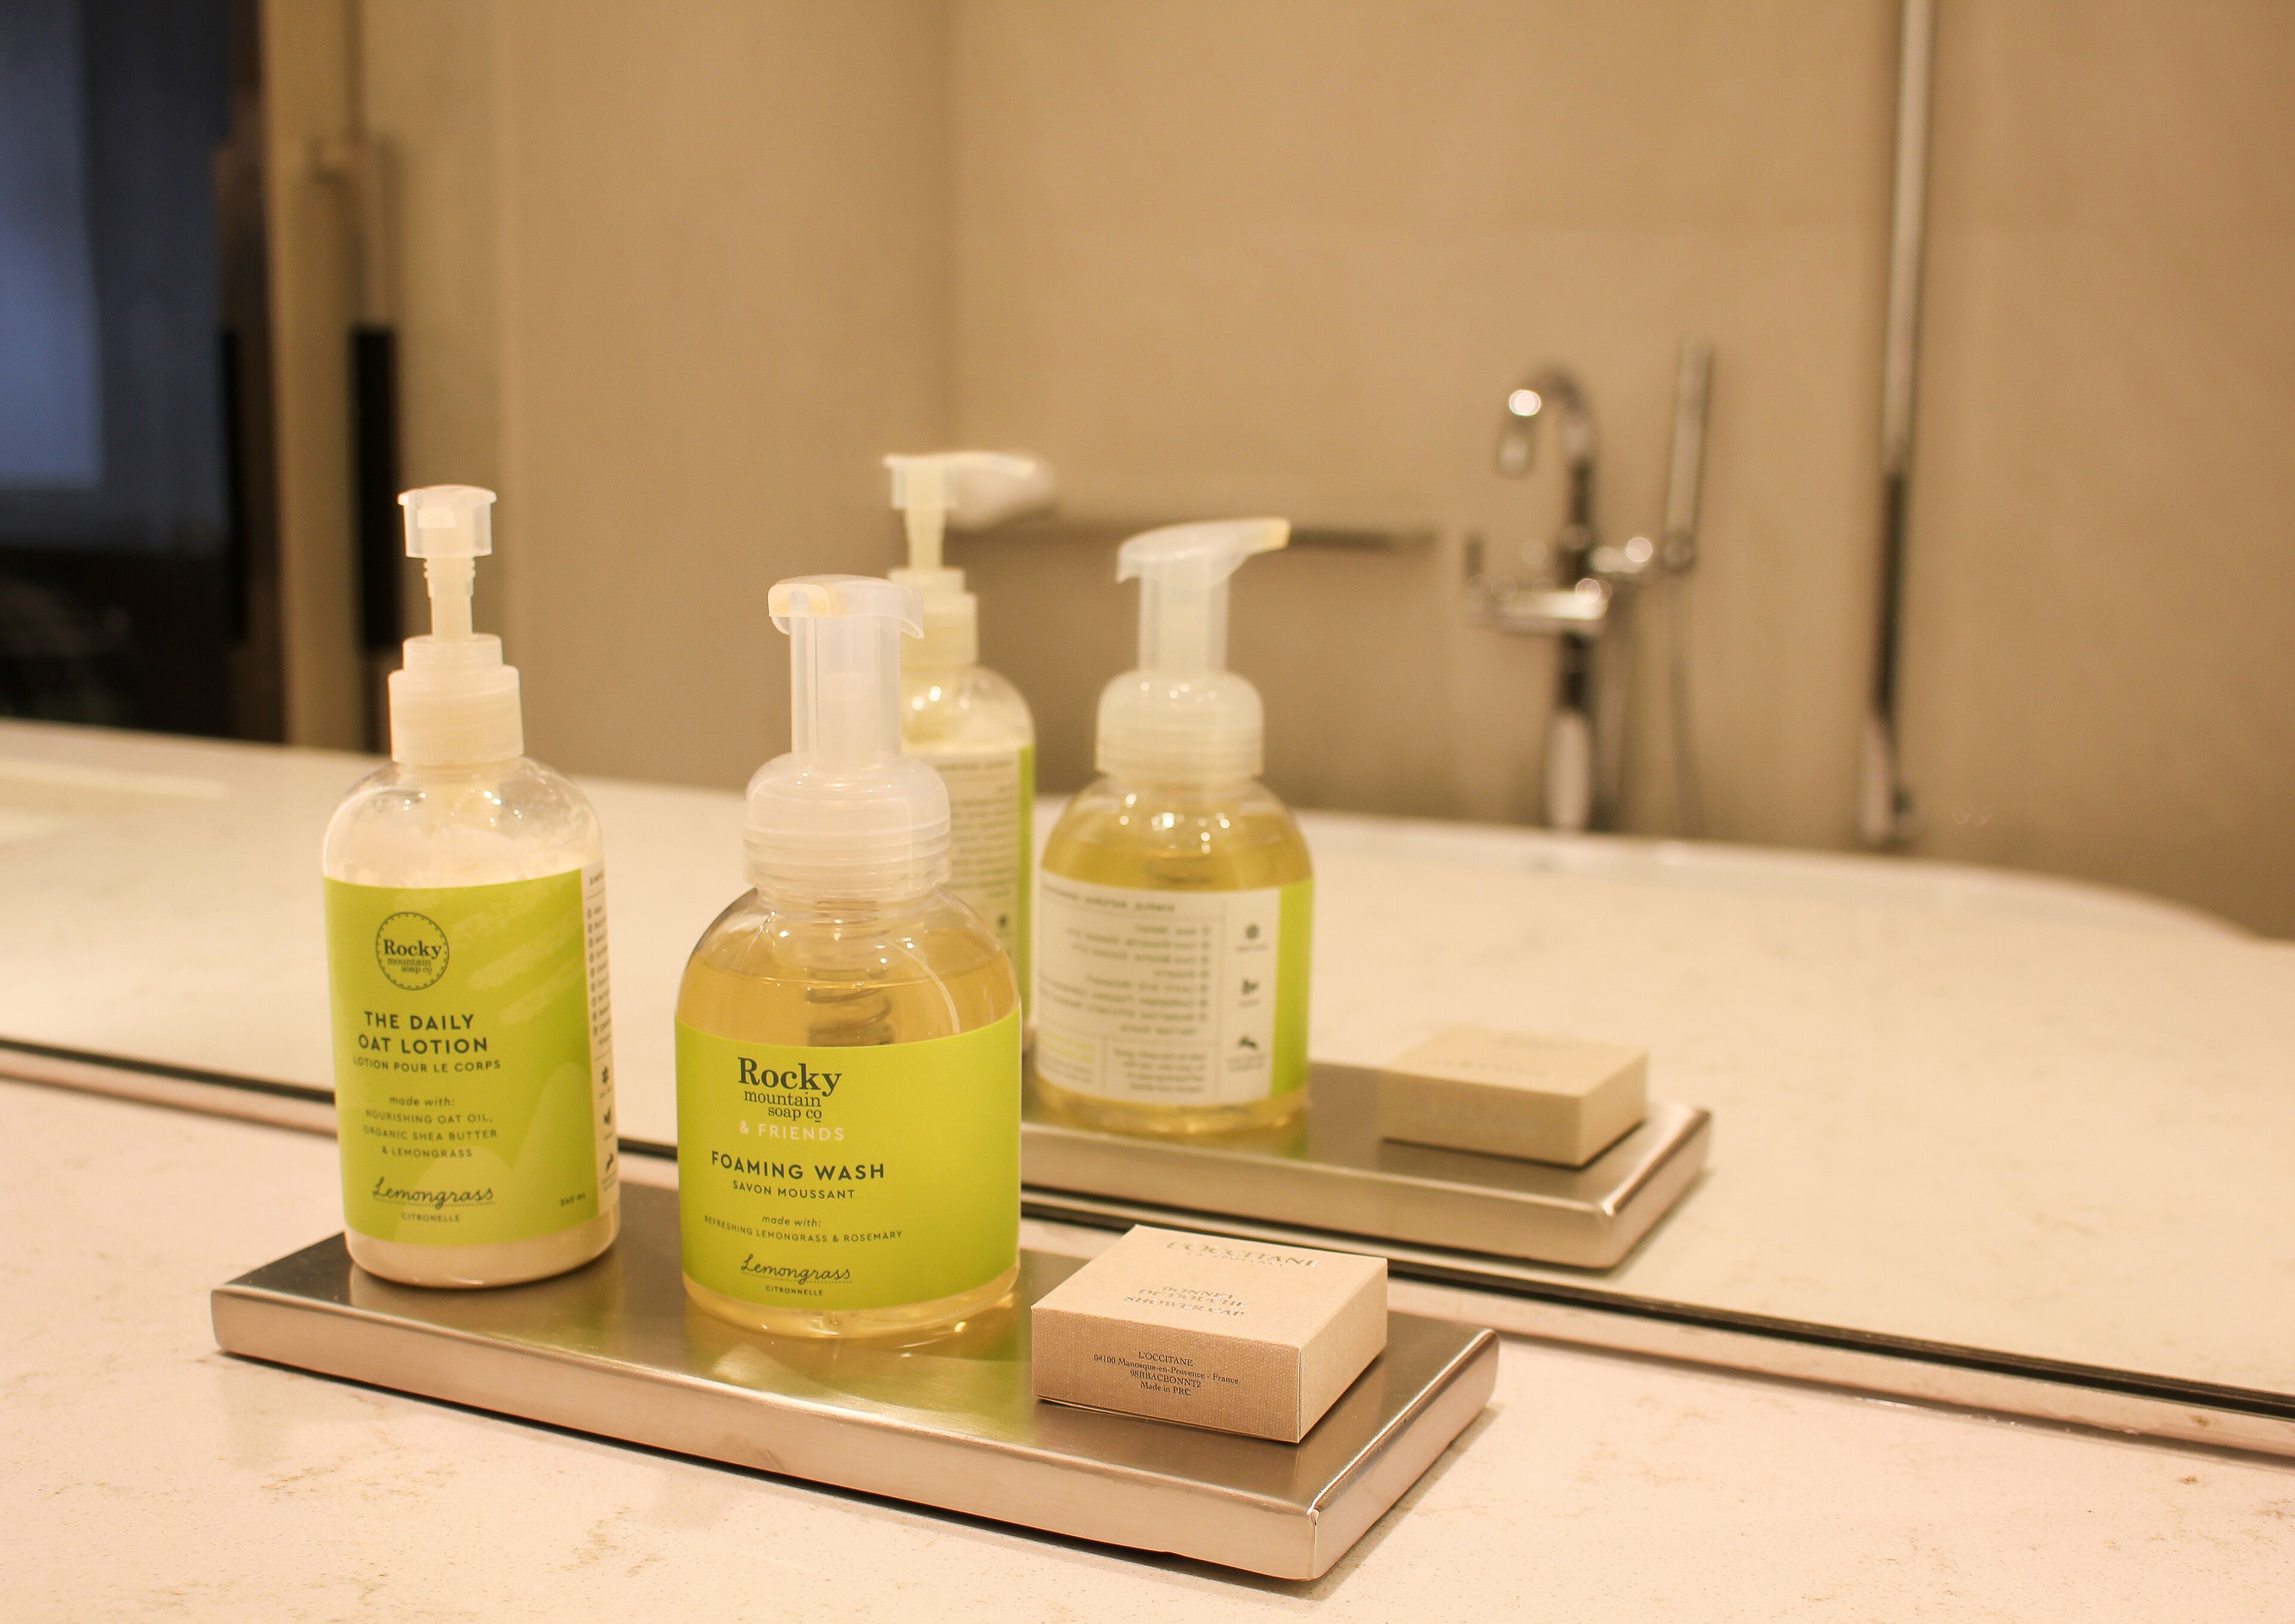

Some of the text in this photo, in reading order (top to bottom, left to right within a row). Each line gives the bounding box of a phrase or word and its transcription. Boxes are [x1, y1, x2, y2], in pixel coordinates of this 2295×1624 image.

[383, 939, 442, 958] Rocky
[365, 1011, 474, 1030] THE DAILY
[359, 1034, 488, 1055] OAT LOTION
[353, 1057, 501, 1073] LOTION POUR LE CORPS
[738, 1057, 842, 1096] Rocky
[390, 1096, 455, 1106] made with:
[743, 1090, 821, 1107] mountain
[366, 1110, 493, 1124] NOURISHING OAT OIL,
[767, 1105, 801, 1122] soap
[363, 1125, 497, 1141] ORGANIC SHEA BUTTER
[740, 1120, 844, 1141] & FRIENDS
[382, 1145, 472, 1158] & LEMONGRASS
[712, 1151, 885, 1181] FOAMING WASH
[372, 1176, 494, 1209] Lemongrass
[733, 1180, 855, 1199] SAVON MOUSSANT
[704, 1215, 903, 1243] REFRESHING LEMONGRASS & ROSEMARY
[762, 1215, 821, 1227] made with:
[740, 1254, 851, 1285] Lemongrass
[766, 1286, 824, 1296] CITRONNELLE
[1094, 1353, 1116, 1364] 04100
[1118, 1358, 1205, 1379] Manosque-en-Provence
[1213, 1373, 1239, 1384] France
[1139, 1351, 1194, 1367] L'OCCITANE
[1130, 1369, 1201, 1388] 98BBACBONNT2
[1141, 1381, 1161, 1391] Made
[1173, 1386, 1191, 1396] PRC
